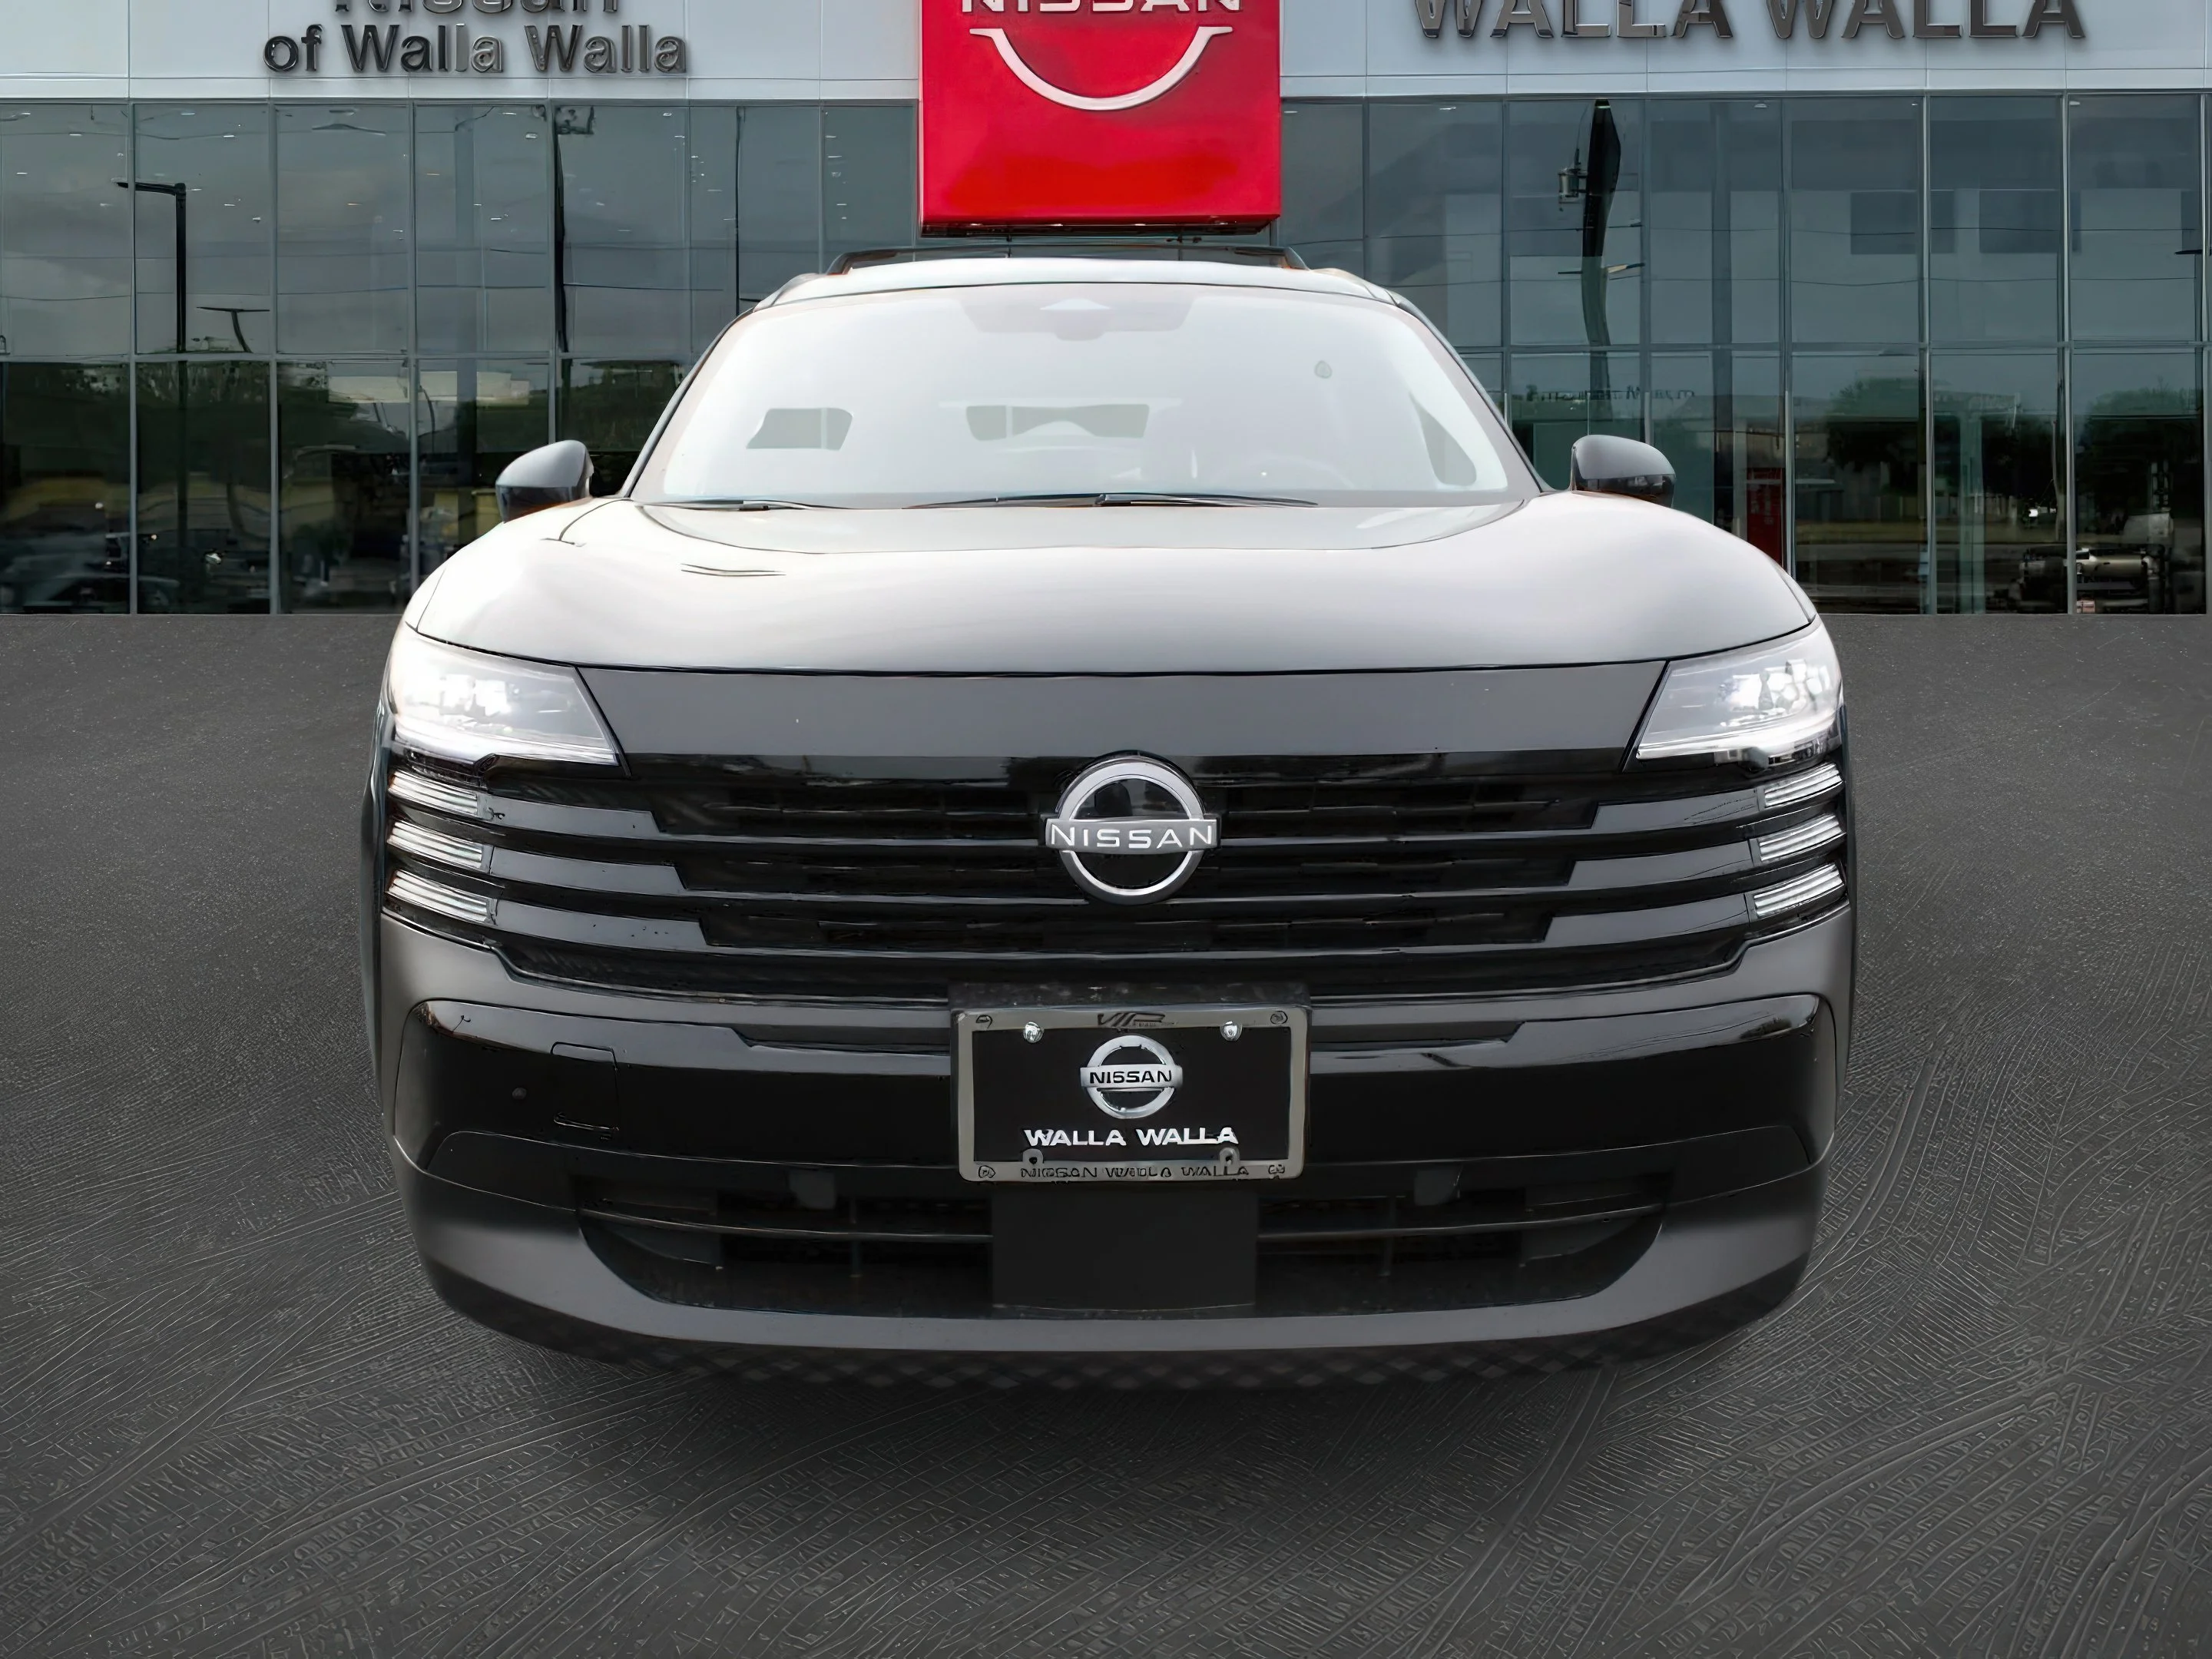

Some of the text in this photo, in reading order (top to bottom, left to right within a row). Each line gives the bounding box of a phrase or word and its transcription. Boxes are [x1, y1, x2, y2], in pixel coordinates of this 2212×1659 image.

[263, 23, 687, 73] of Walla Walla
[1051, 824, 1212, 849] NISSAN
[1089, 1070, 1173, 1085] NISSAN
[1024, 1127, 1240, 1147] WALLA WALLA
